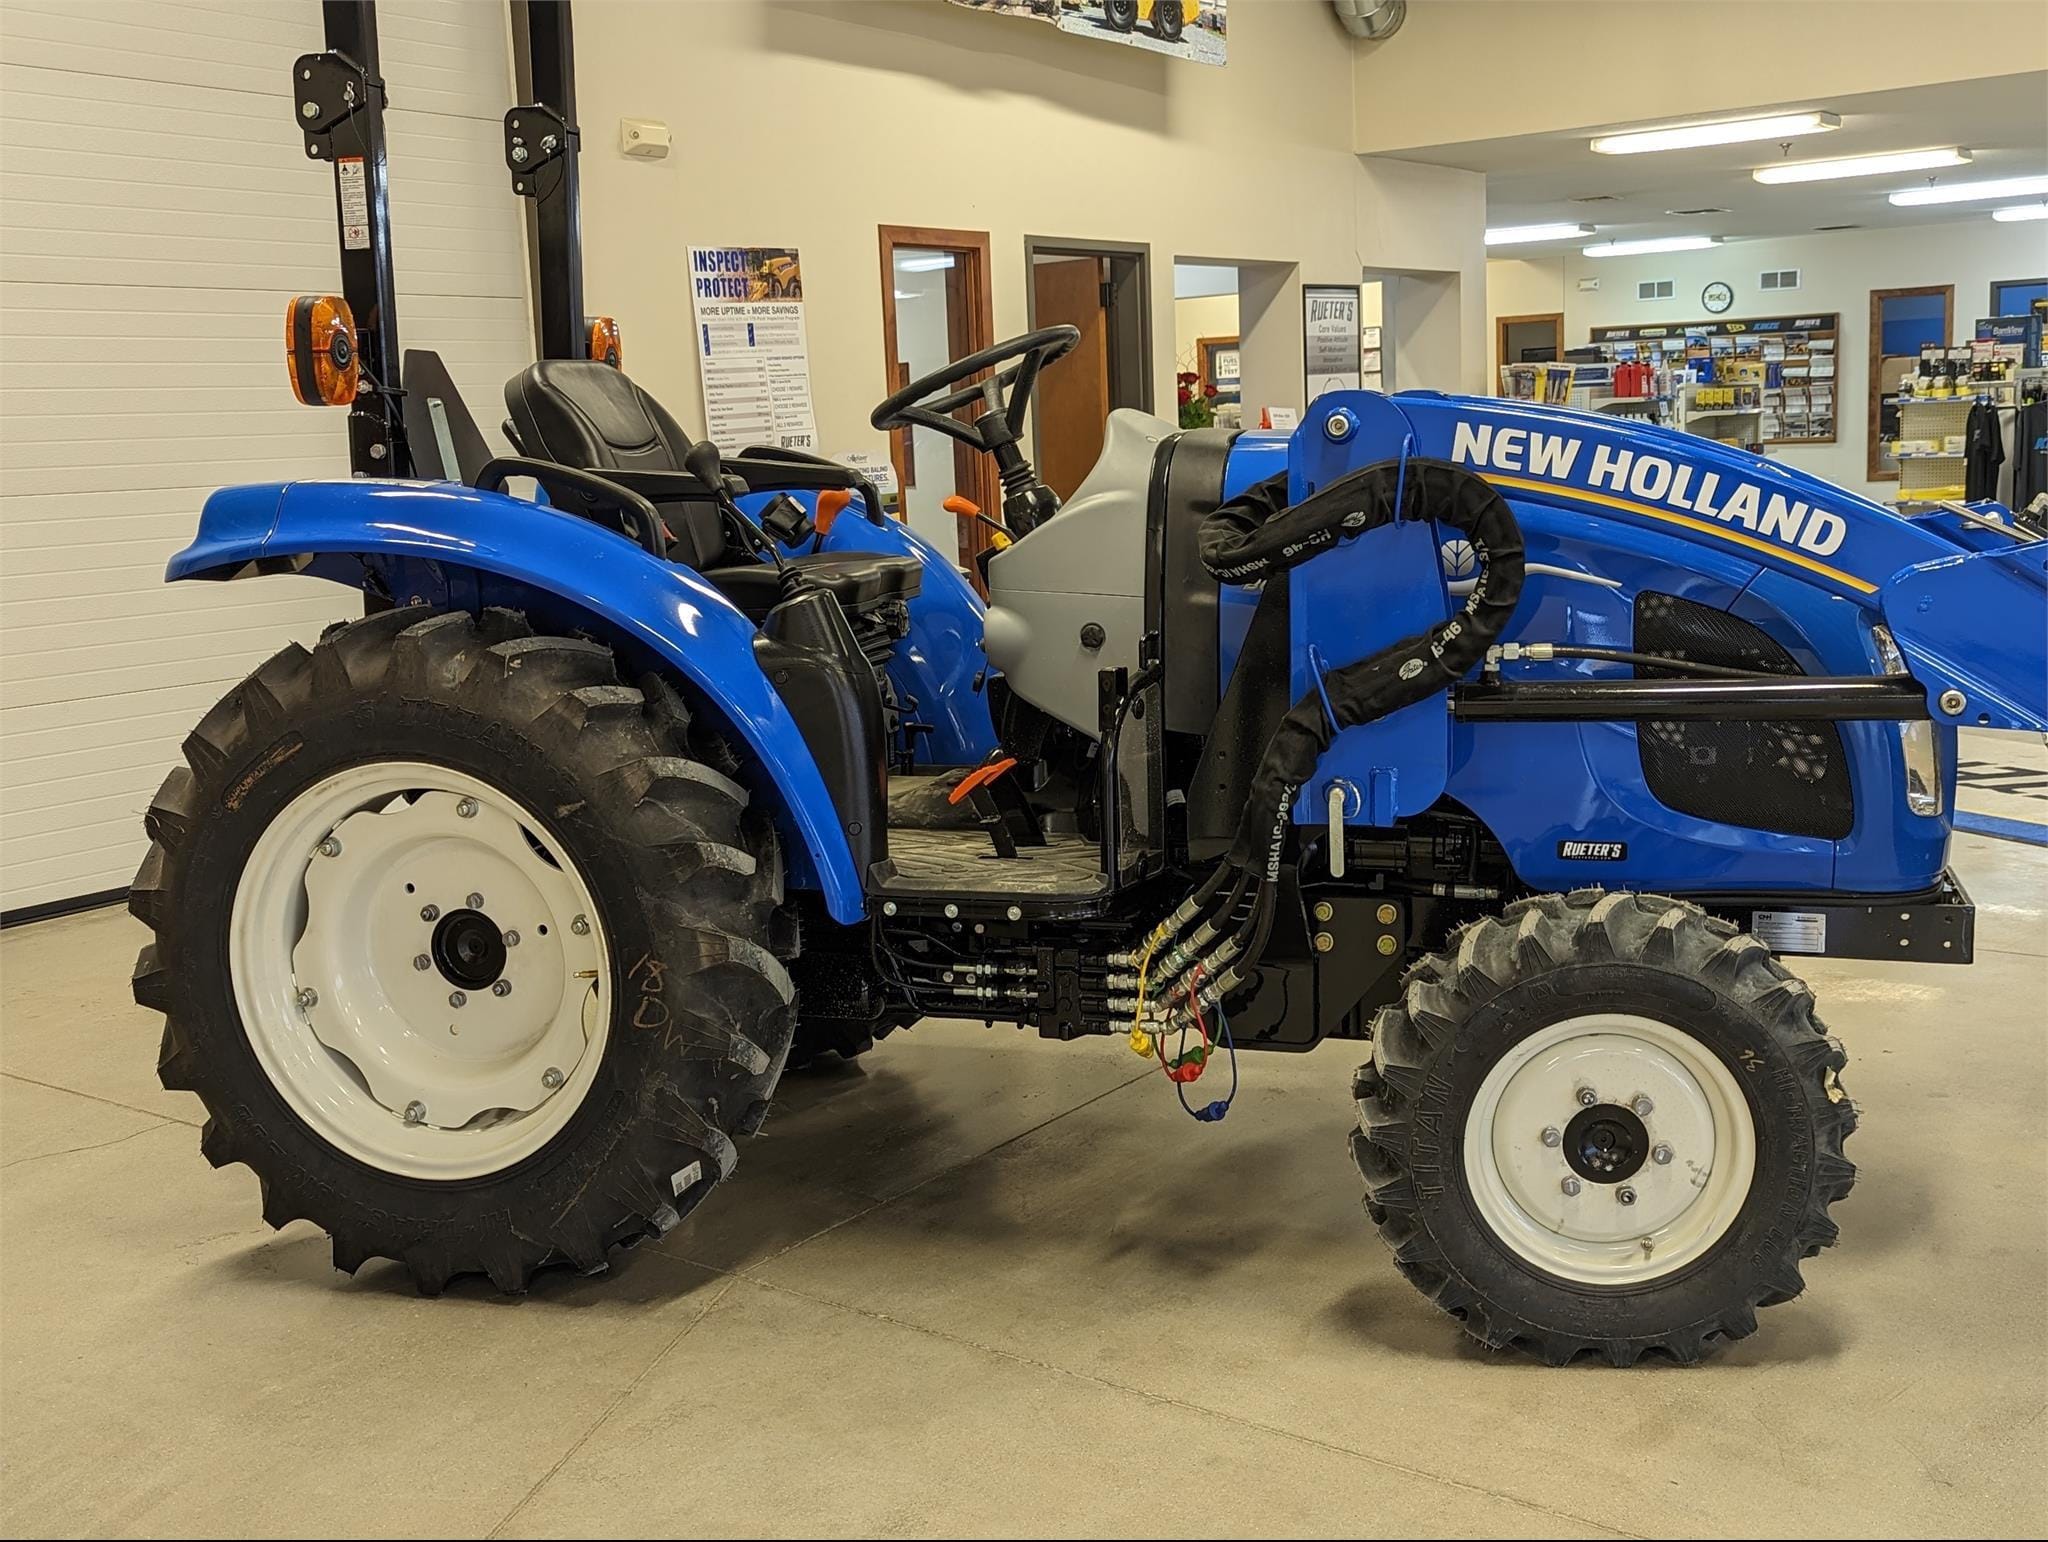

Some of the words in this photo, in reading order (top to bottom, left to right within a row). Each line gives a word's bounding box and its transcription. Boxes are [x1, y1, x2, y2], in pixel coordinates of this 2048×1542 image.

[693, 250, 748, 272] INSPECT
[696, 277, 748, 298] PROTECT
[701, 307, 720, 315] MORE
[721, 306, 746, 315] UPTIME
[752, 306, 770, 315] MORE
[772, 305, 799, 314] SAVINGS
[1310, 300, 1353, 322] RUETER'S
[781, 435, 811, 448] RUETER'S
[1451, 422, 1582, 479] NEW
[1587, 444, 1847, 557] HOLLAND
[1562, 842, 1622, 858] RUETER'S
[1267, 841, 1281, 882] MSHA
[1418, 1073, 1455, 1201] TITAN
